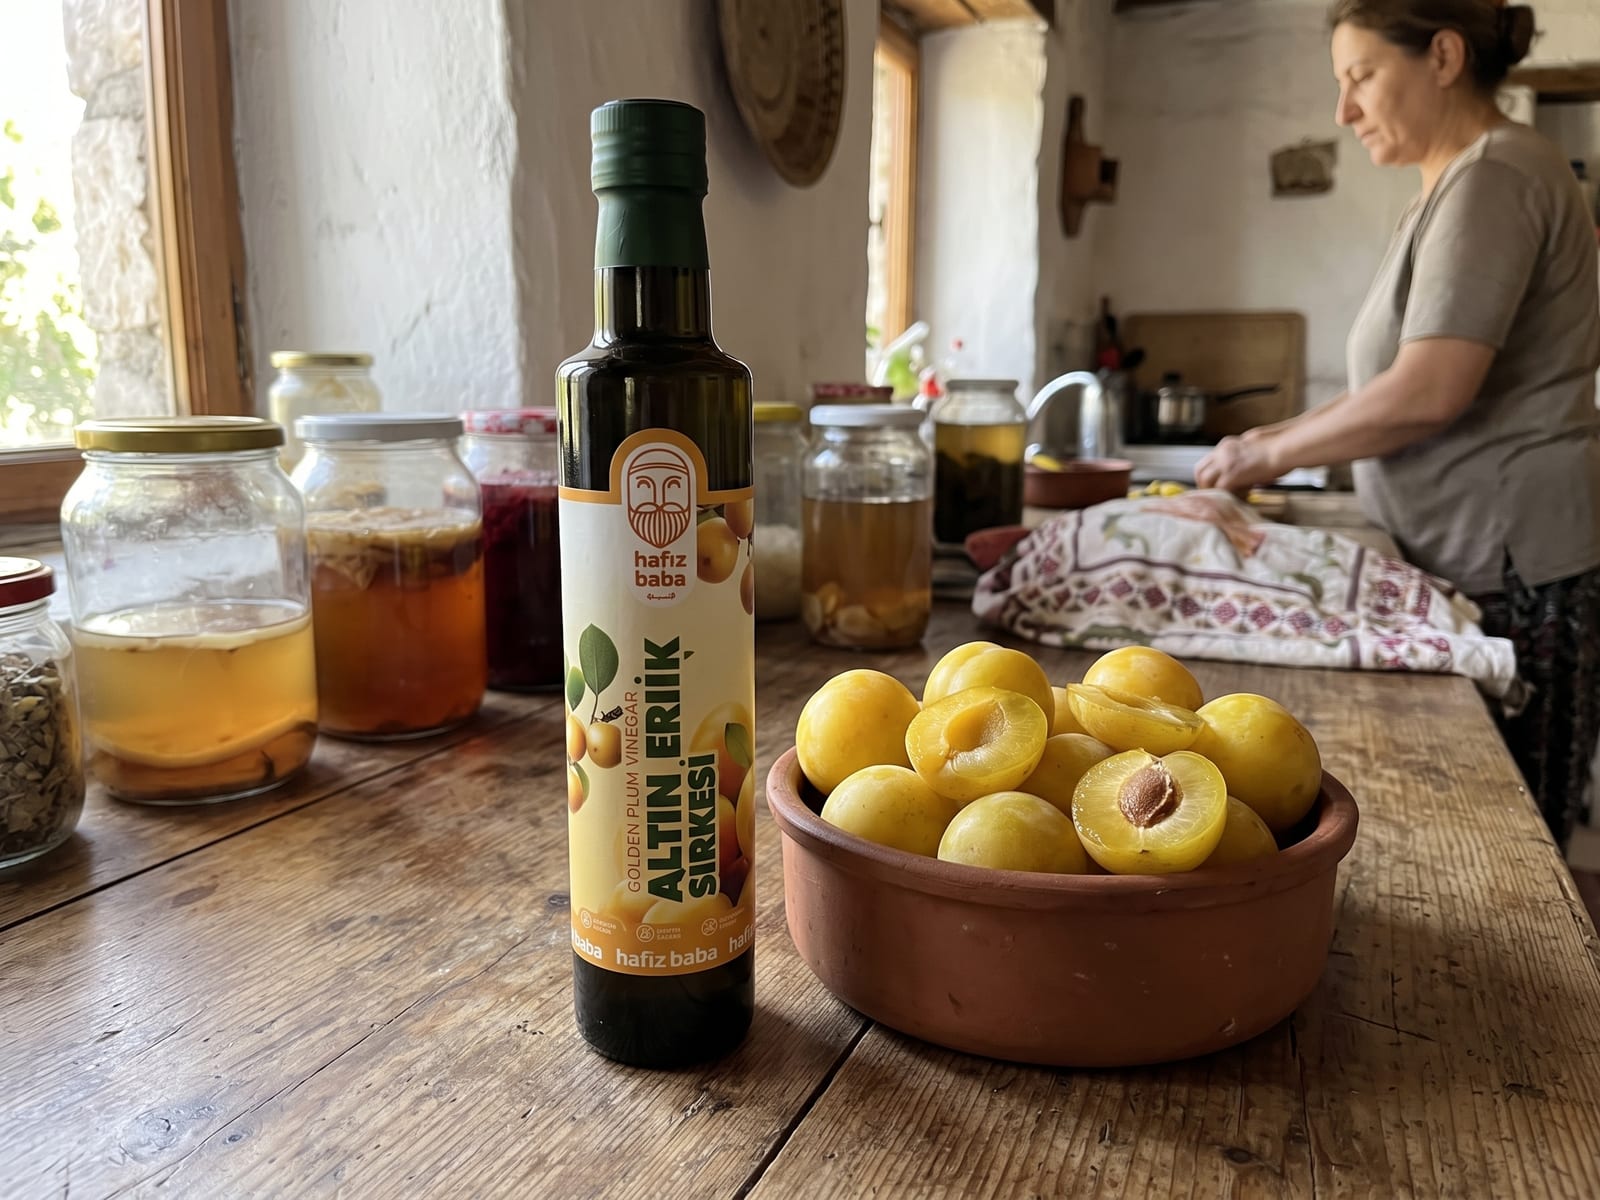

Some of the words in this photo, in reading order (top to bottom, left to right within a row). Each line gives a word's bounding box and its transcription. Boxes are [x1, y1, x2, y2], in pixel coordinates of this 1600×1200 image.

[634, 570, 686, 587] baba
[624, 691, 639, 766] VINEGAR
[626, 771, 640, 818] PLUM
[627, 823, 641, 893] GOLDEN
[646, 773, 684, 903] ALTIN
[670, 947, 718, 967] baba
